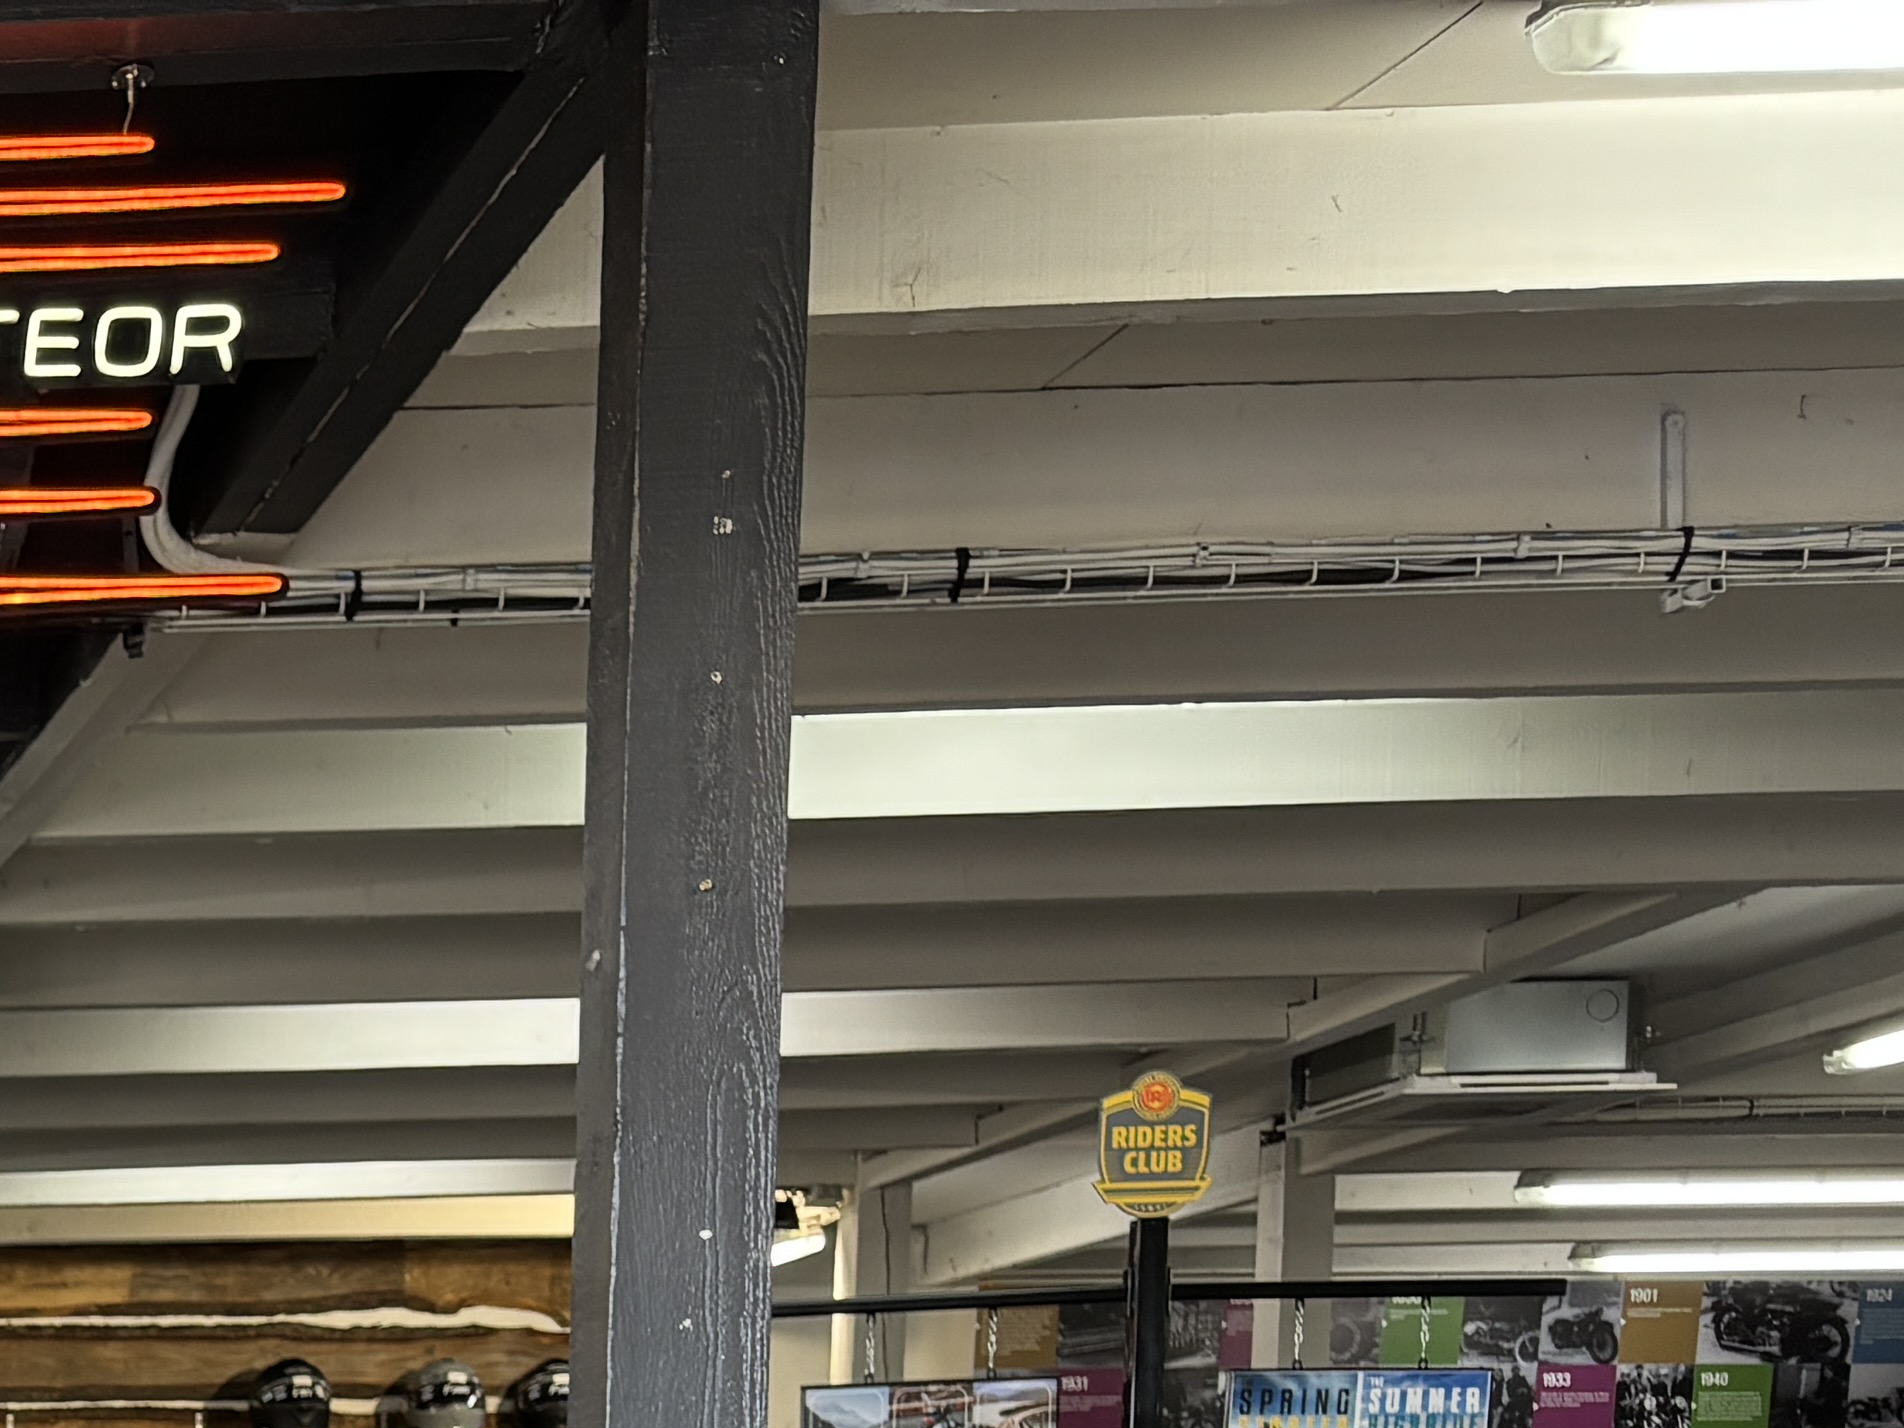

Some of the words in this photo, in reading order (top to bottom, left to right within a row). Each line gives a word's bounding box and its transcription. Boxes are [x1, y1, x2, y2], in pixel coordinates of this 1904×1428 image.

[1111, 1124, 1198, 1149] RIDERS
[1123, 1150, 1183, 1174] CLUB
[1629, 1288, 1658, 1303] 1901
[1542, 1371, 1571, 1388] 1933
[1700, 1371, 1729, 1388] 1940
[1239, 1388, 1351, 1415] SPRING
[1368, 1386, 1481, 1414] SUMMER
